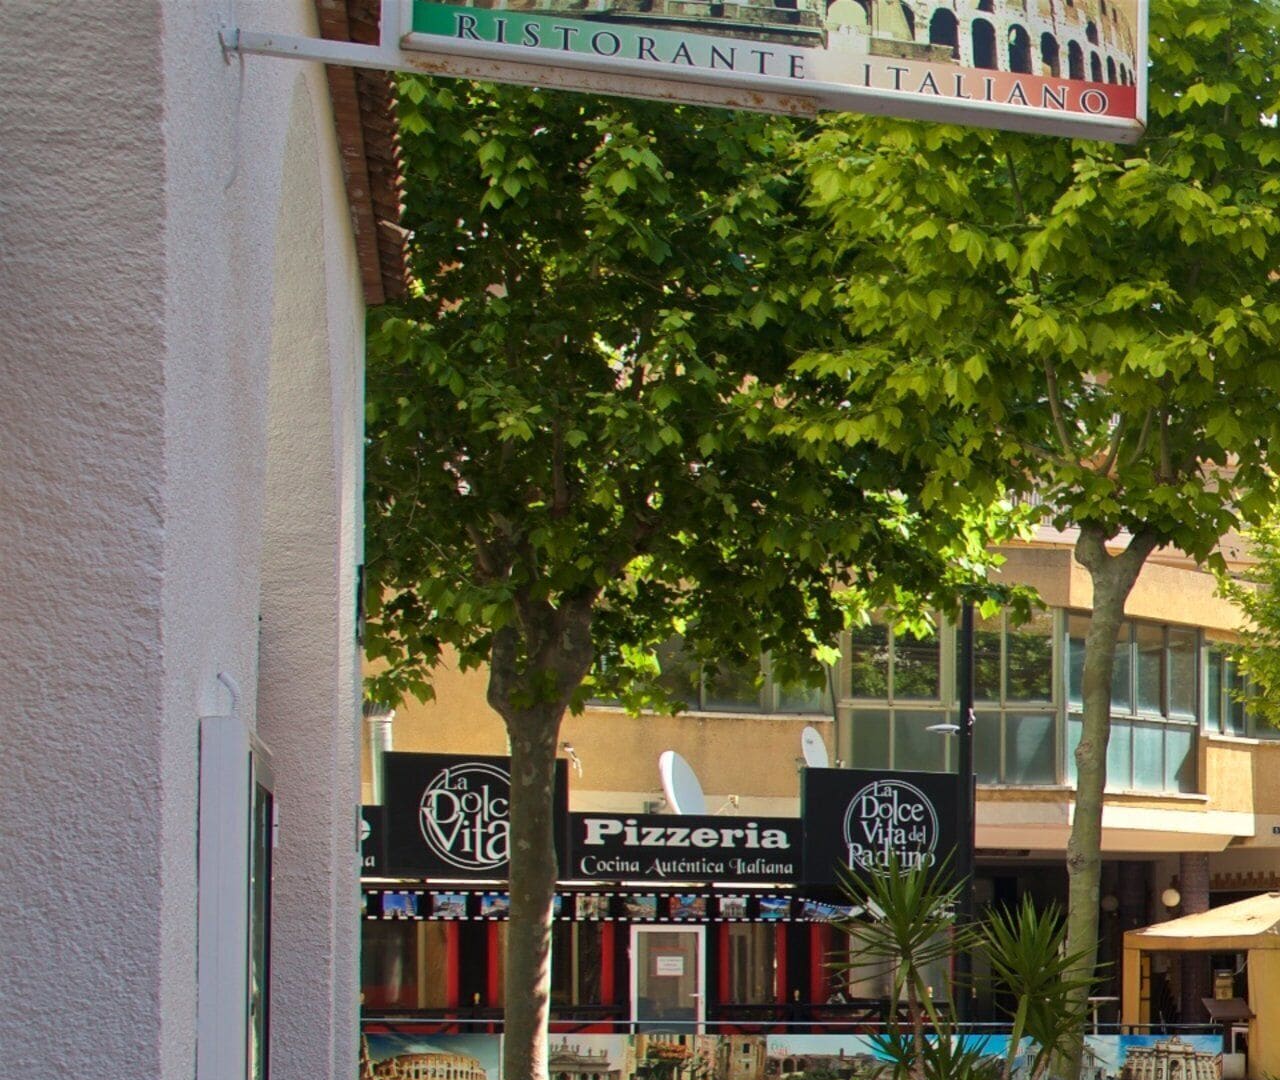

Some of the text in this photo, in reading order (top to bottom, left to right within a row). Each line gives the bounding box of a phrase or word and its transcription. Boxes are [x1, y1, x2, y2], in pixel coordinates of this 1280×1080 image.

[455, 13, 1108, 114] RISTORANTE ITALIANO
[443, 769, 468, 790] La
[873, 781, 892, 797] La
[427, 785, 510, 823] Dolc
[860, 790, 925, 825] Dolce
[420, 806, 510, 864] Vita
[584, 818, 790, 849] Pizzeria
[860, 817, 926, 845] Vita del
[580, 855, 793, 877] Cocina Auténtica Italiana
